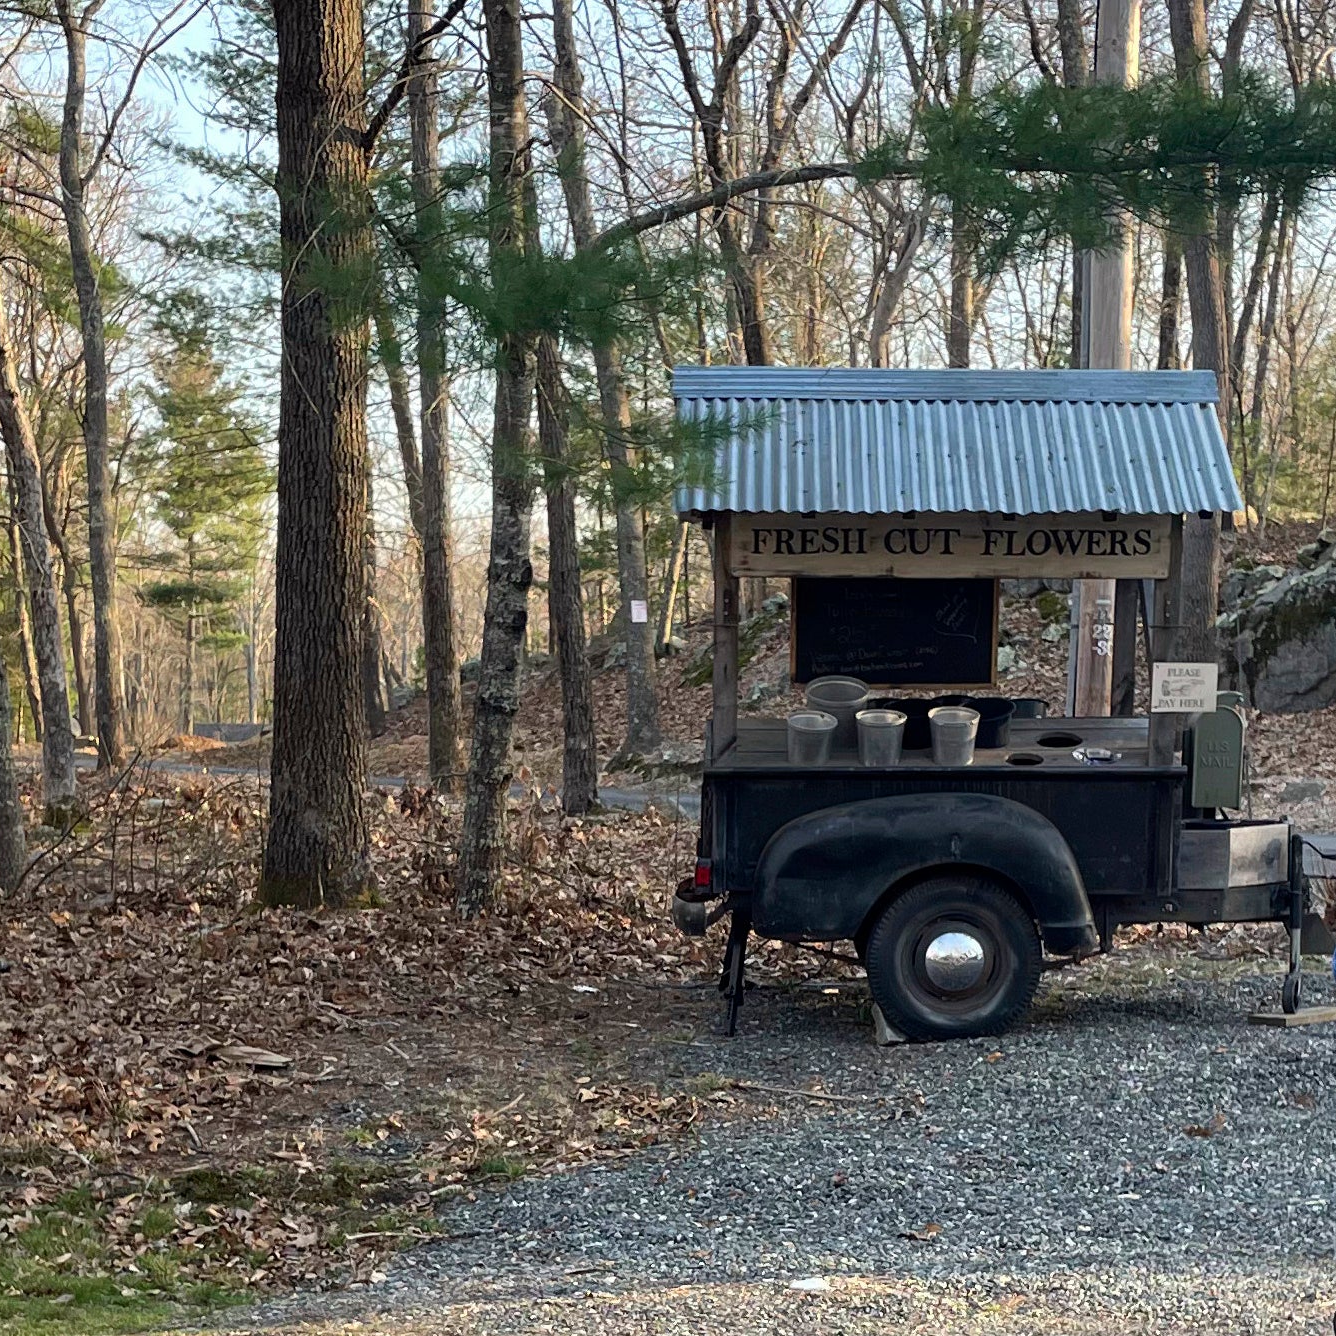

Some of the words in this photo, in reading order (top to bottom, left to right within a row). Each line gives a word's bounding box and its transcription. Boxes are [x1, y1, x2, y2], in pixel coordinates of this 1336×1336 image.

[751, 527, 867, 555] FRESH
[883, 527, 961, 555] CUT
[980, 528, 1152, 556] FLOWERS
[1167, 668, 1200, 677] PLEASE
[1158, 699, 1176, 708] PAY
[1179, 699, 1204, 708] HERE
[1199, 756, 1234, 768] MAIL
